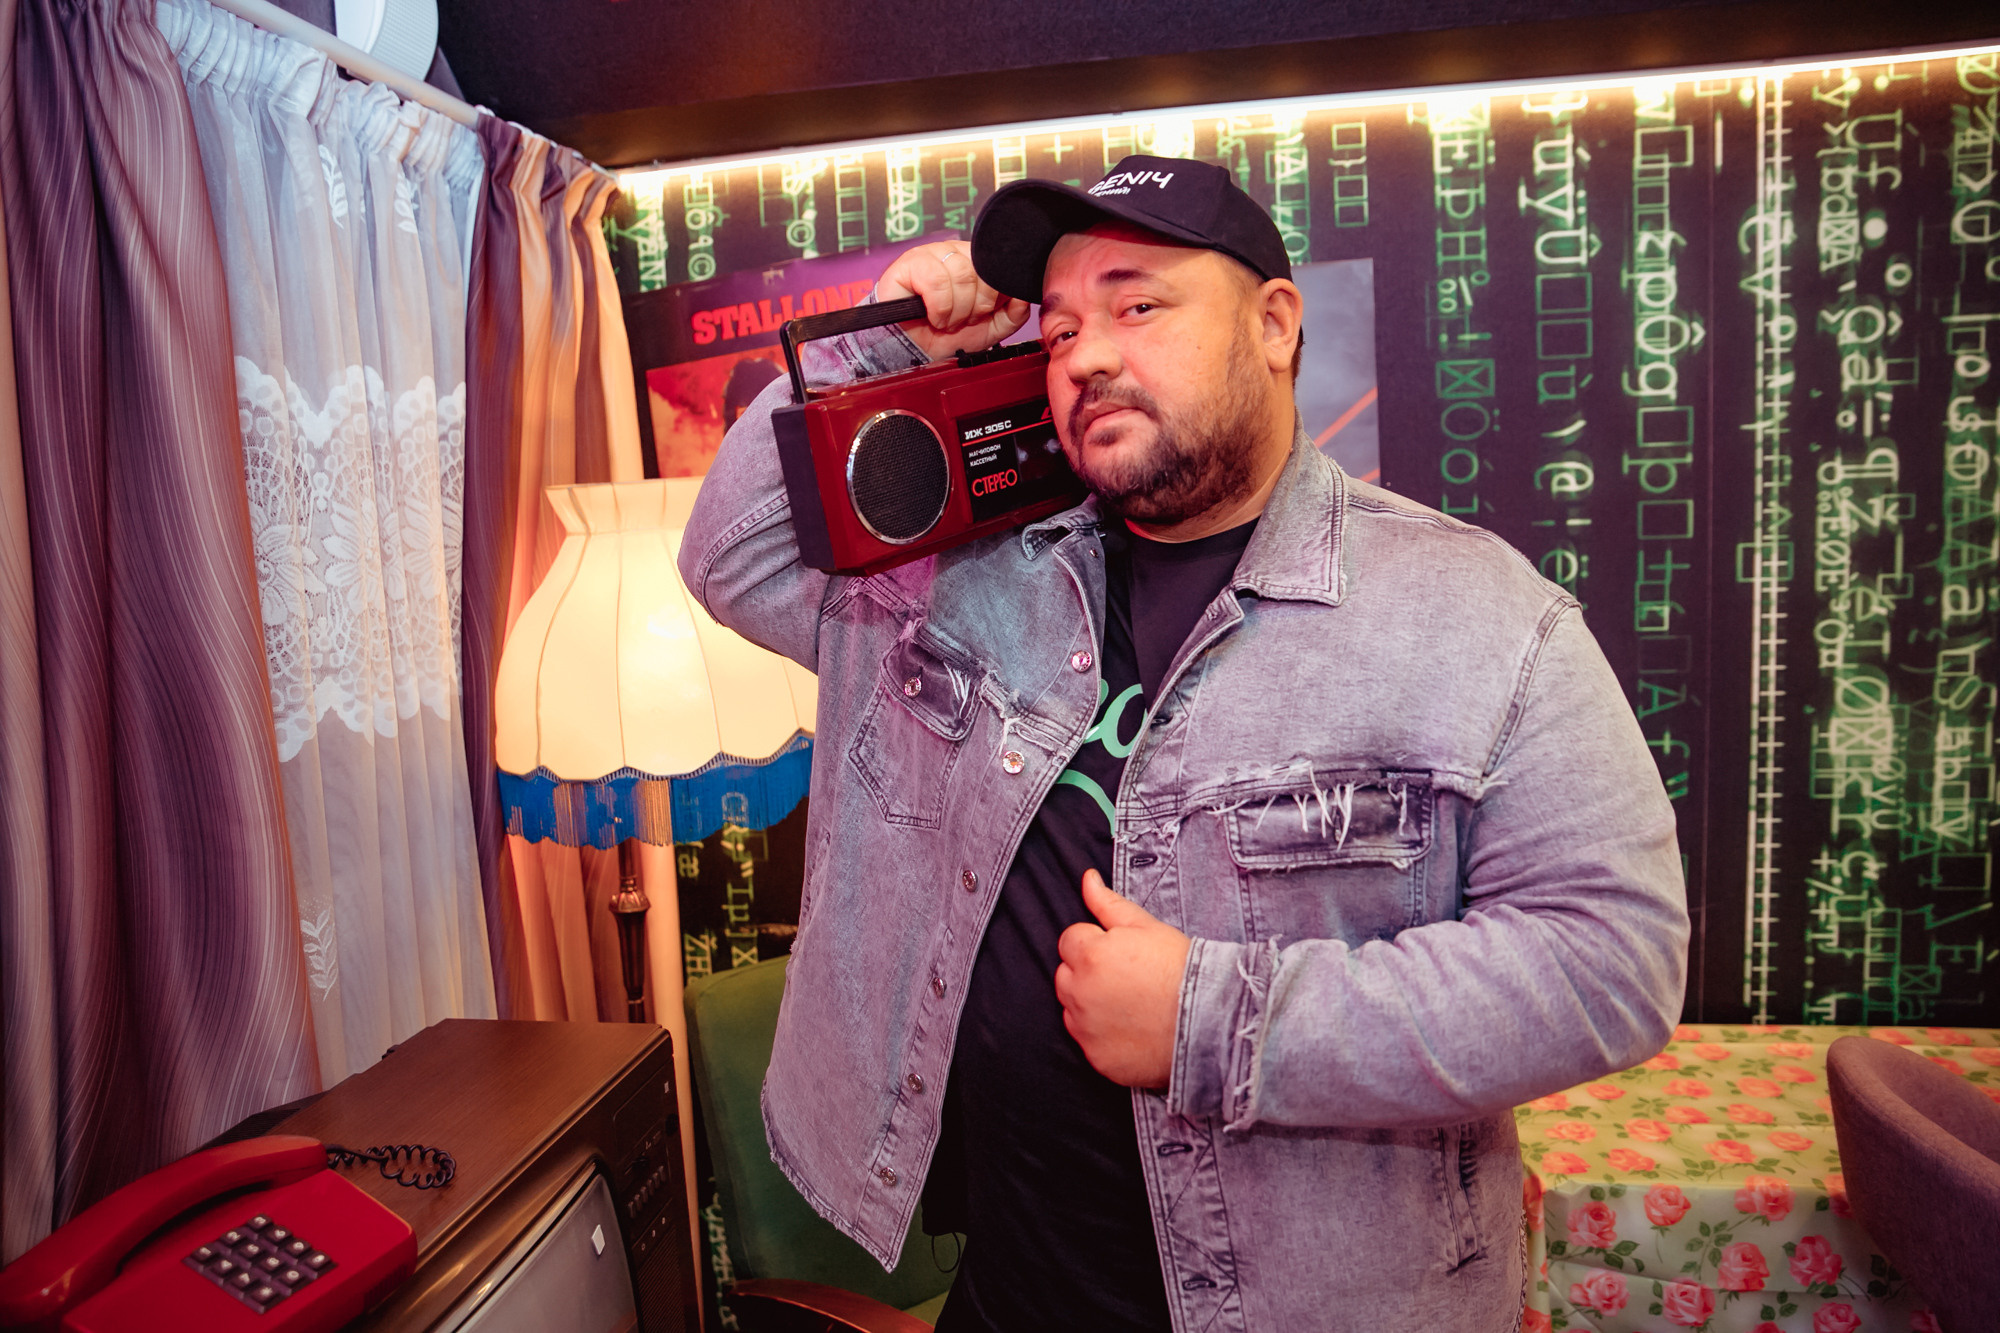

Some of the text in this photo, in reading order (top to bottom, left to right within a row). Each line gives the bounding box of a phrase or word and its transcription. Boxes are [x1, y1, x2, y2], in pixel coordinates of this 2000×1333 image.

[964, 428, 984, 440] ИЖ
[969, 453, 998, 467] КАССЕТНЫЙ
[971, 468, 1018, 497] СТЕРЕО
